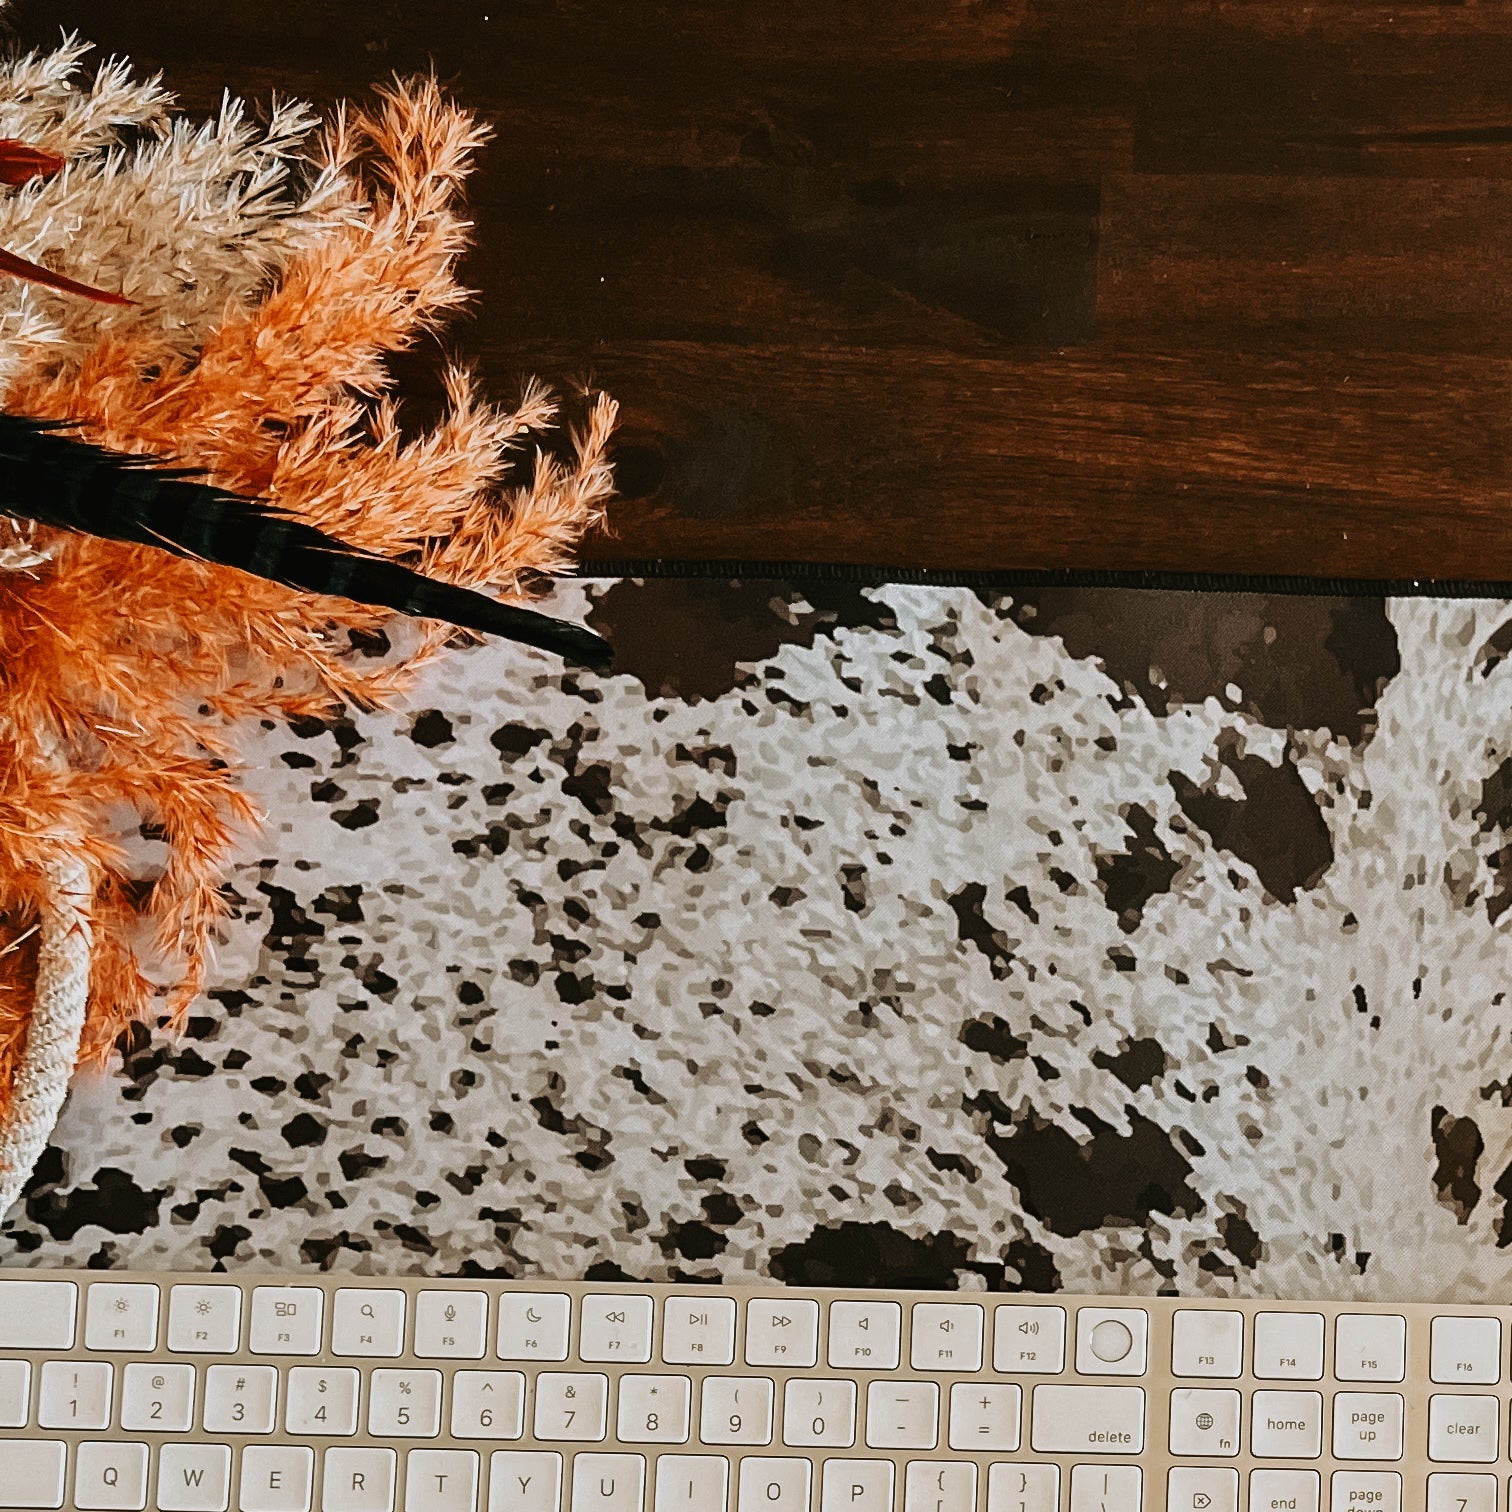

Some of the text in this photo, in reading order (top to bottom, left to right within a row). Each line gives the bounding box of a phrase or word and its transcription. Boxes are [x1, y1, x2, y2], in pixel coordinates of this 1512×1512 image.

[113, 1329, 125, 1338] F1
[195, 1331, 209, 1341] F2
[277, 1333, 290, 1342] F3
[359, 1335, 373, 1344] F4
[442, 1336, 455, 1346] F5
[525, 1339, 538, 1348] F6
[608, 1340, 621, 1350] F7
[691, 1343, 704, 1352] F8
[774, 1345, 787, 1354] F9
[854, 1347, 872, 1357] F10
[938, 1349, 953, 1358] F11
[1019, 1351, 1037, 1361] F12
[1198, 1356, 1215, 1365] F13
[1279, 1358, 1297, 1367] F14
[1361, 1360, 1378, 1369] F15
[1456, 1362, 1473, 1372] F16
[69, 1399, 77, 1417] 1
[150, 1401, 163, 1420] 2
[231, 1402, 245, 1422] 3
[314, 1405, 328, 1423] 4
[397, 1406, 410, 1425] 5
[480, 1408, 493, 1427] 6
[563, 1410, 576, 1429] 7
[645, 1412, 659, 1432] 8
[1351, 1412, 1385, 1426] page
[729, 1414, 742, 1433] 9
[1267, 1417, 1306, 1431] home
[1446, 1422, 1481, 1435] clear
[1088, 1430, 1132, 1444] delete
[1219, 1438, 1231, 1449] fn
[1359, 1430, 1377, 1443] up
[103, 1466, 118, 1488] Q
[183, 1468, 205, 1488] W
[269, 1471, 283, 1490] E
[352, 1472, 365, 1491] R
[434, 1474, 449, 1493] T
[517, 1476, 532, 1495] Y
[600, 1478, 615, 1497] U
[766, 1482, 781, 1501] O
[851, 1484, 865, 1503] P
[1349, 1490, 1383, 1504] page
[1270, 1497, 1297, 1510] end
